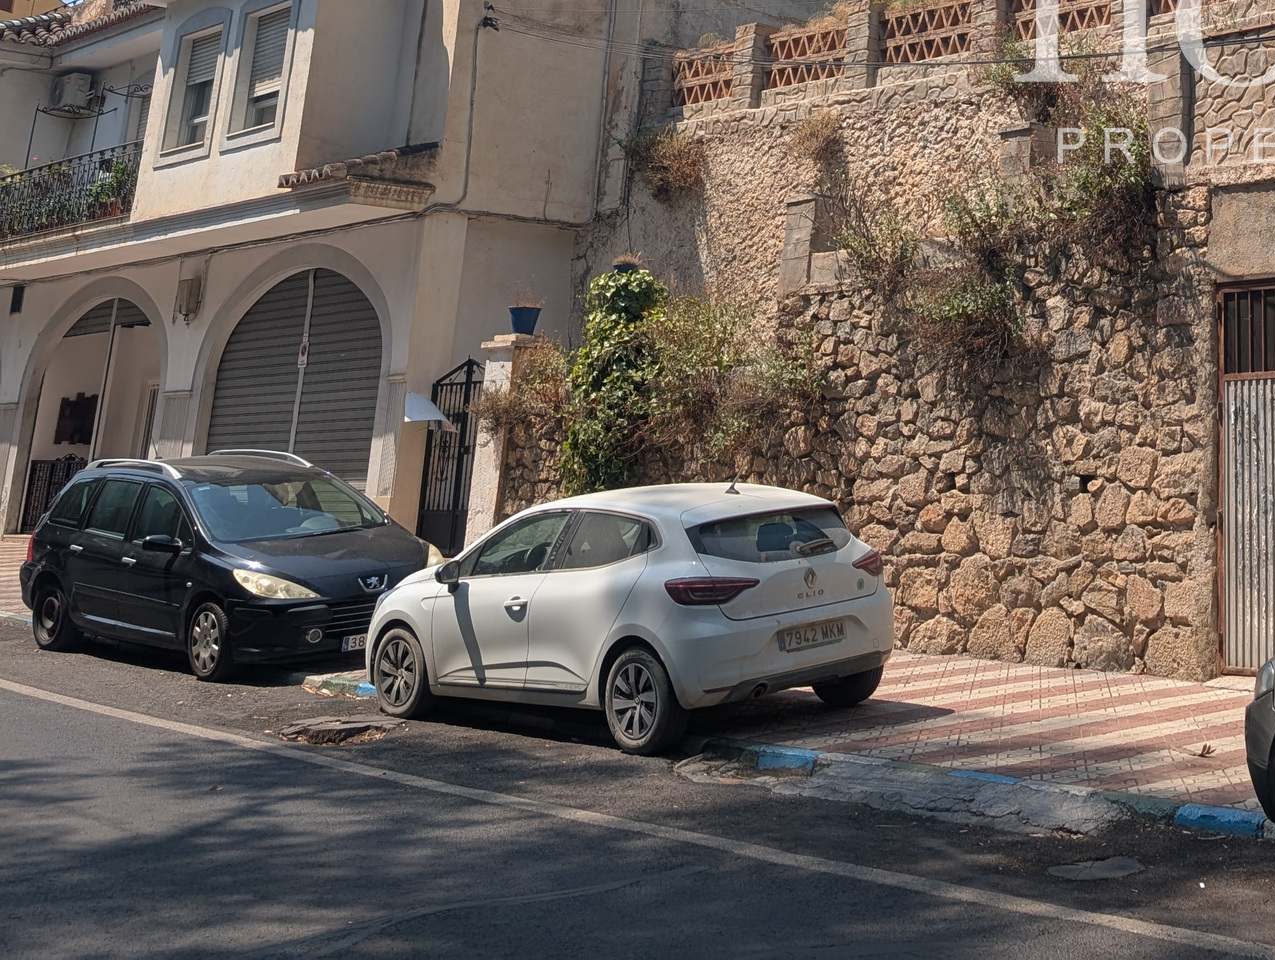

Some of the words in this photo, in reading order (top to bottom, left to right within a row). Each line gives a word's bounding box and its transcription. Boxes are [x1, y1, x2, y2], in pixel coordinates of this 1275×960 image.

[797, 589, 825, 600] CLIO
[786, 628, 818, 647] 7942
[820, 622, 845, 640] MKM
[350, 635, 366, 649] 38
